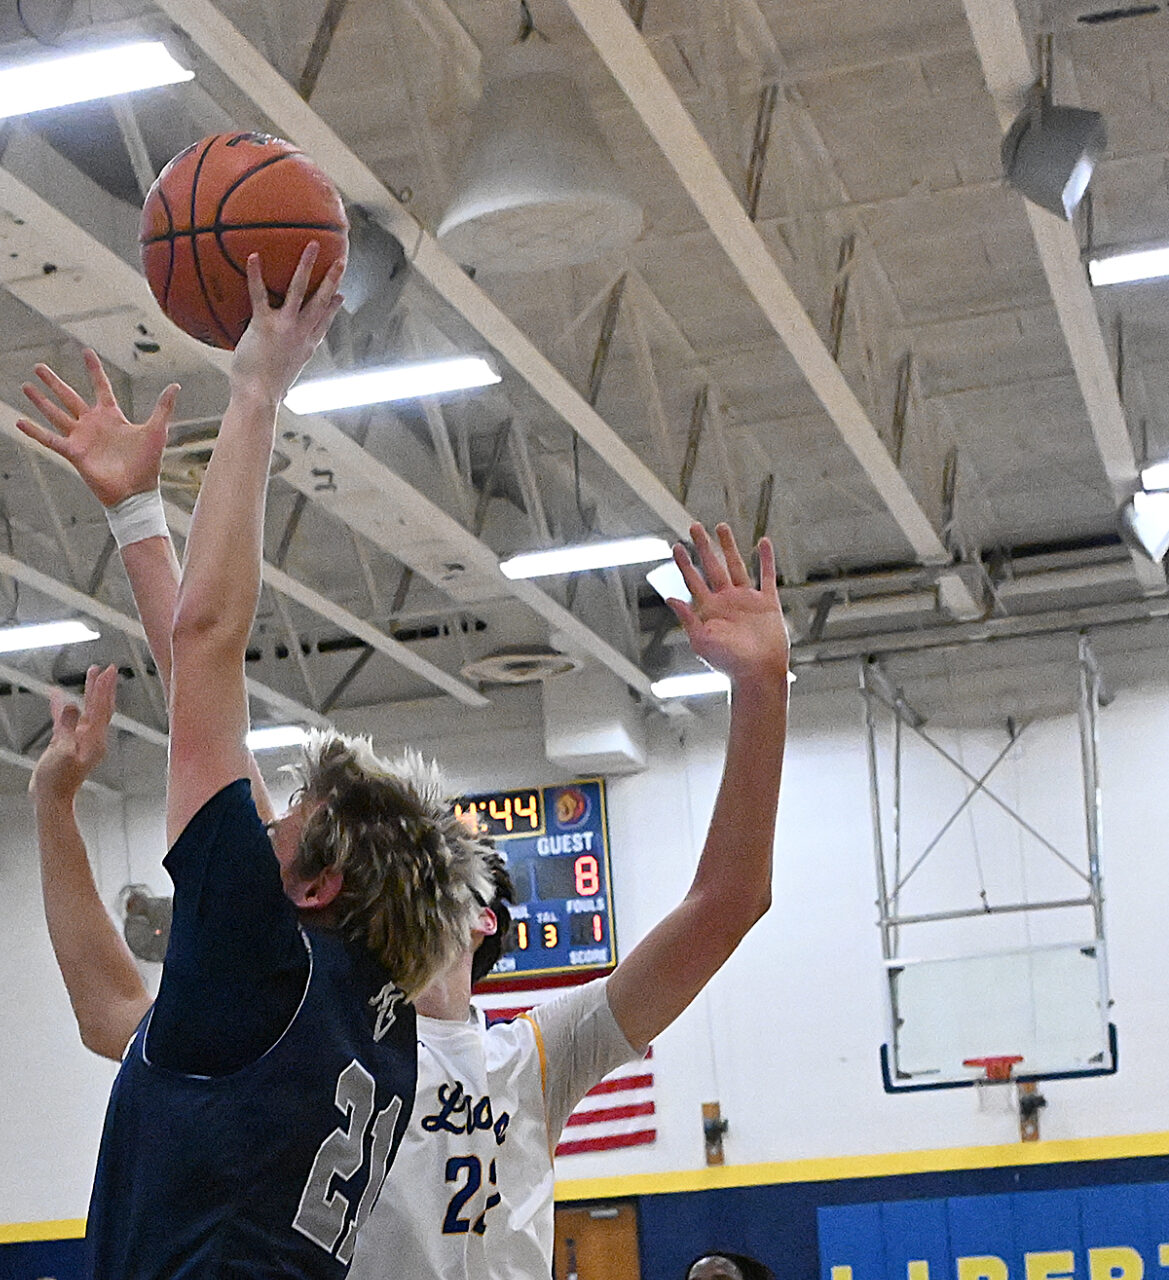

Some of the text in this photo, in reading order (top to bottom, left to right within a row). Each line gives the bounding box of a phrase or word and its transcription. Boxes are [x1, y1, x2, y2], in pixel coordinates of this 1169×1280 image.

[537, 831, 595, 856] GUEST
[574, 855, 600, 896] 8
[566, 897, 605, 914] FOULS
[518, 922, 558, 951] 1 3
[592, 914, 602, 942] 1
[421, 1081, 510, 1146] Lios
[291, 1058, 403, 1265] 21
